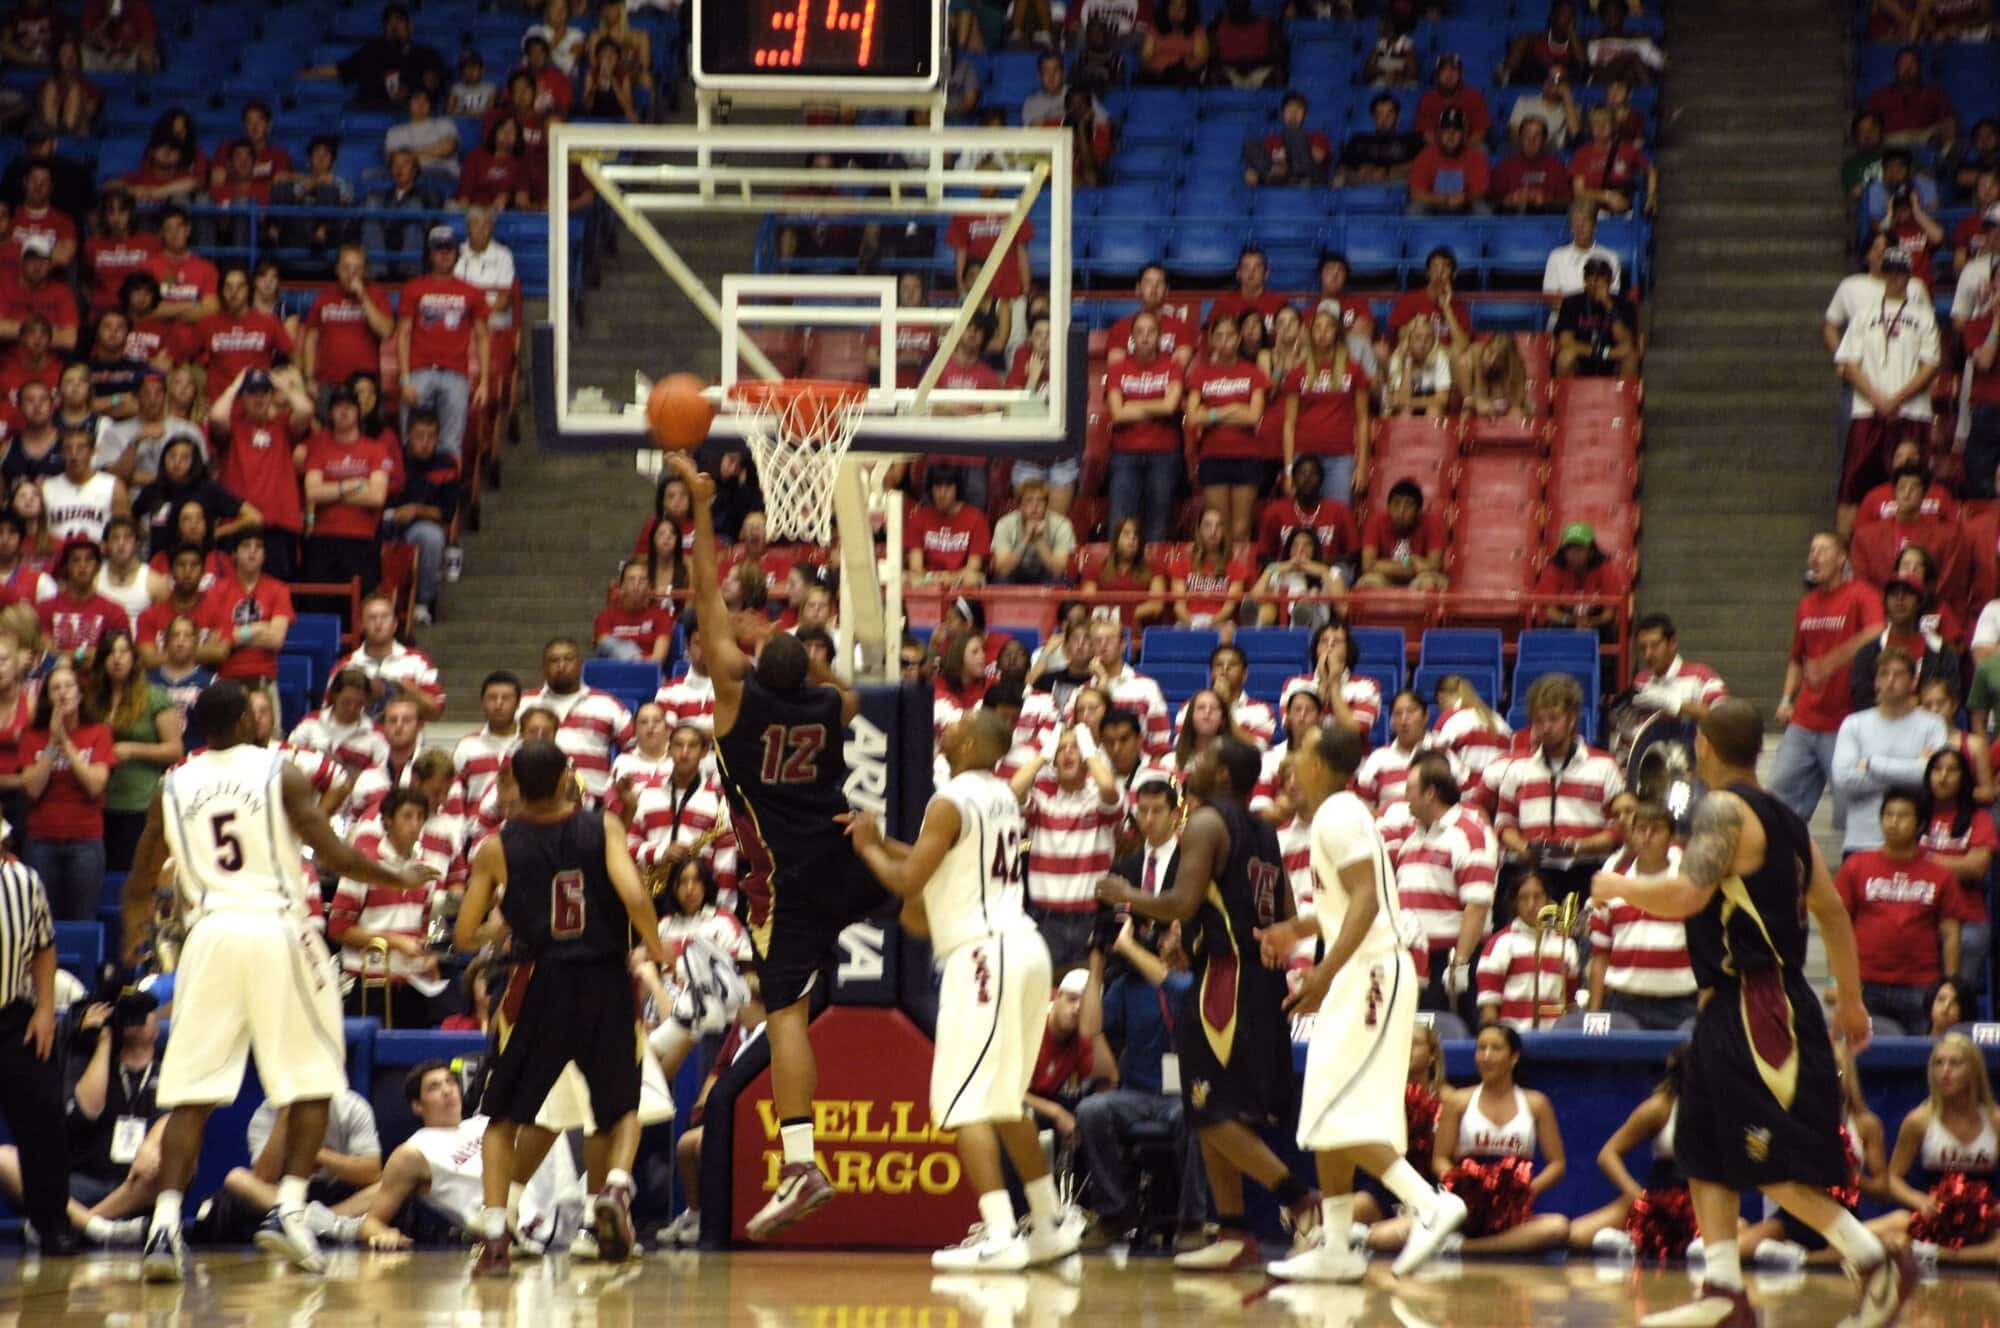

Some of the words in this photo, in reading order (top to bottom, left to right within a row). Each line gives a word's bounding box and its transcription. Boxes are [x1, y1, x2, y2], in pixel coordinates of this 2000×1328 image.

[760, 724, 826, 785] 12
[211, 812, 244, 872] 5
[552, 869, 585, 941] 6
[762, 1150, 961, 1195] FRGO
